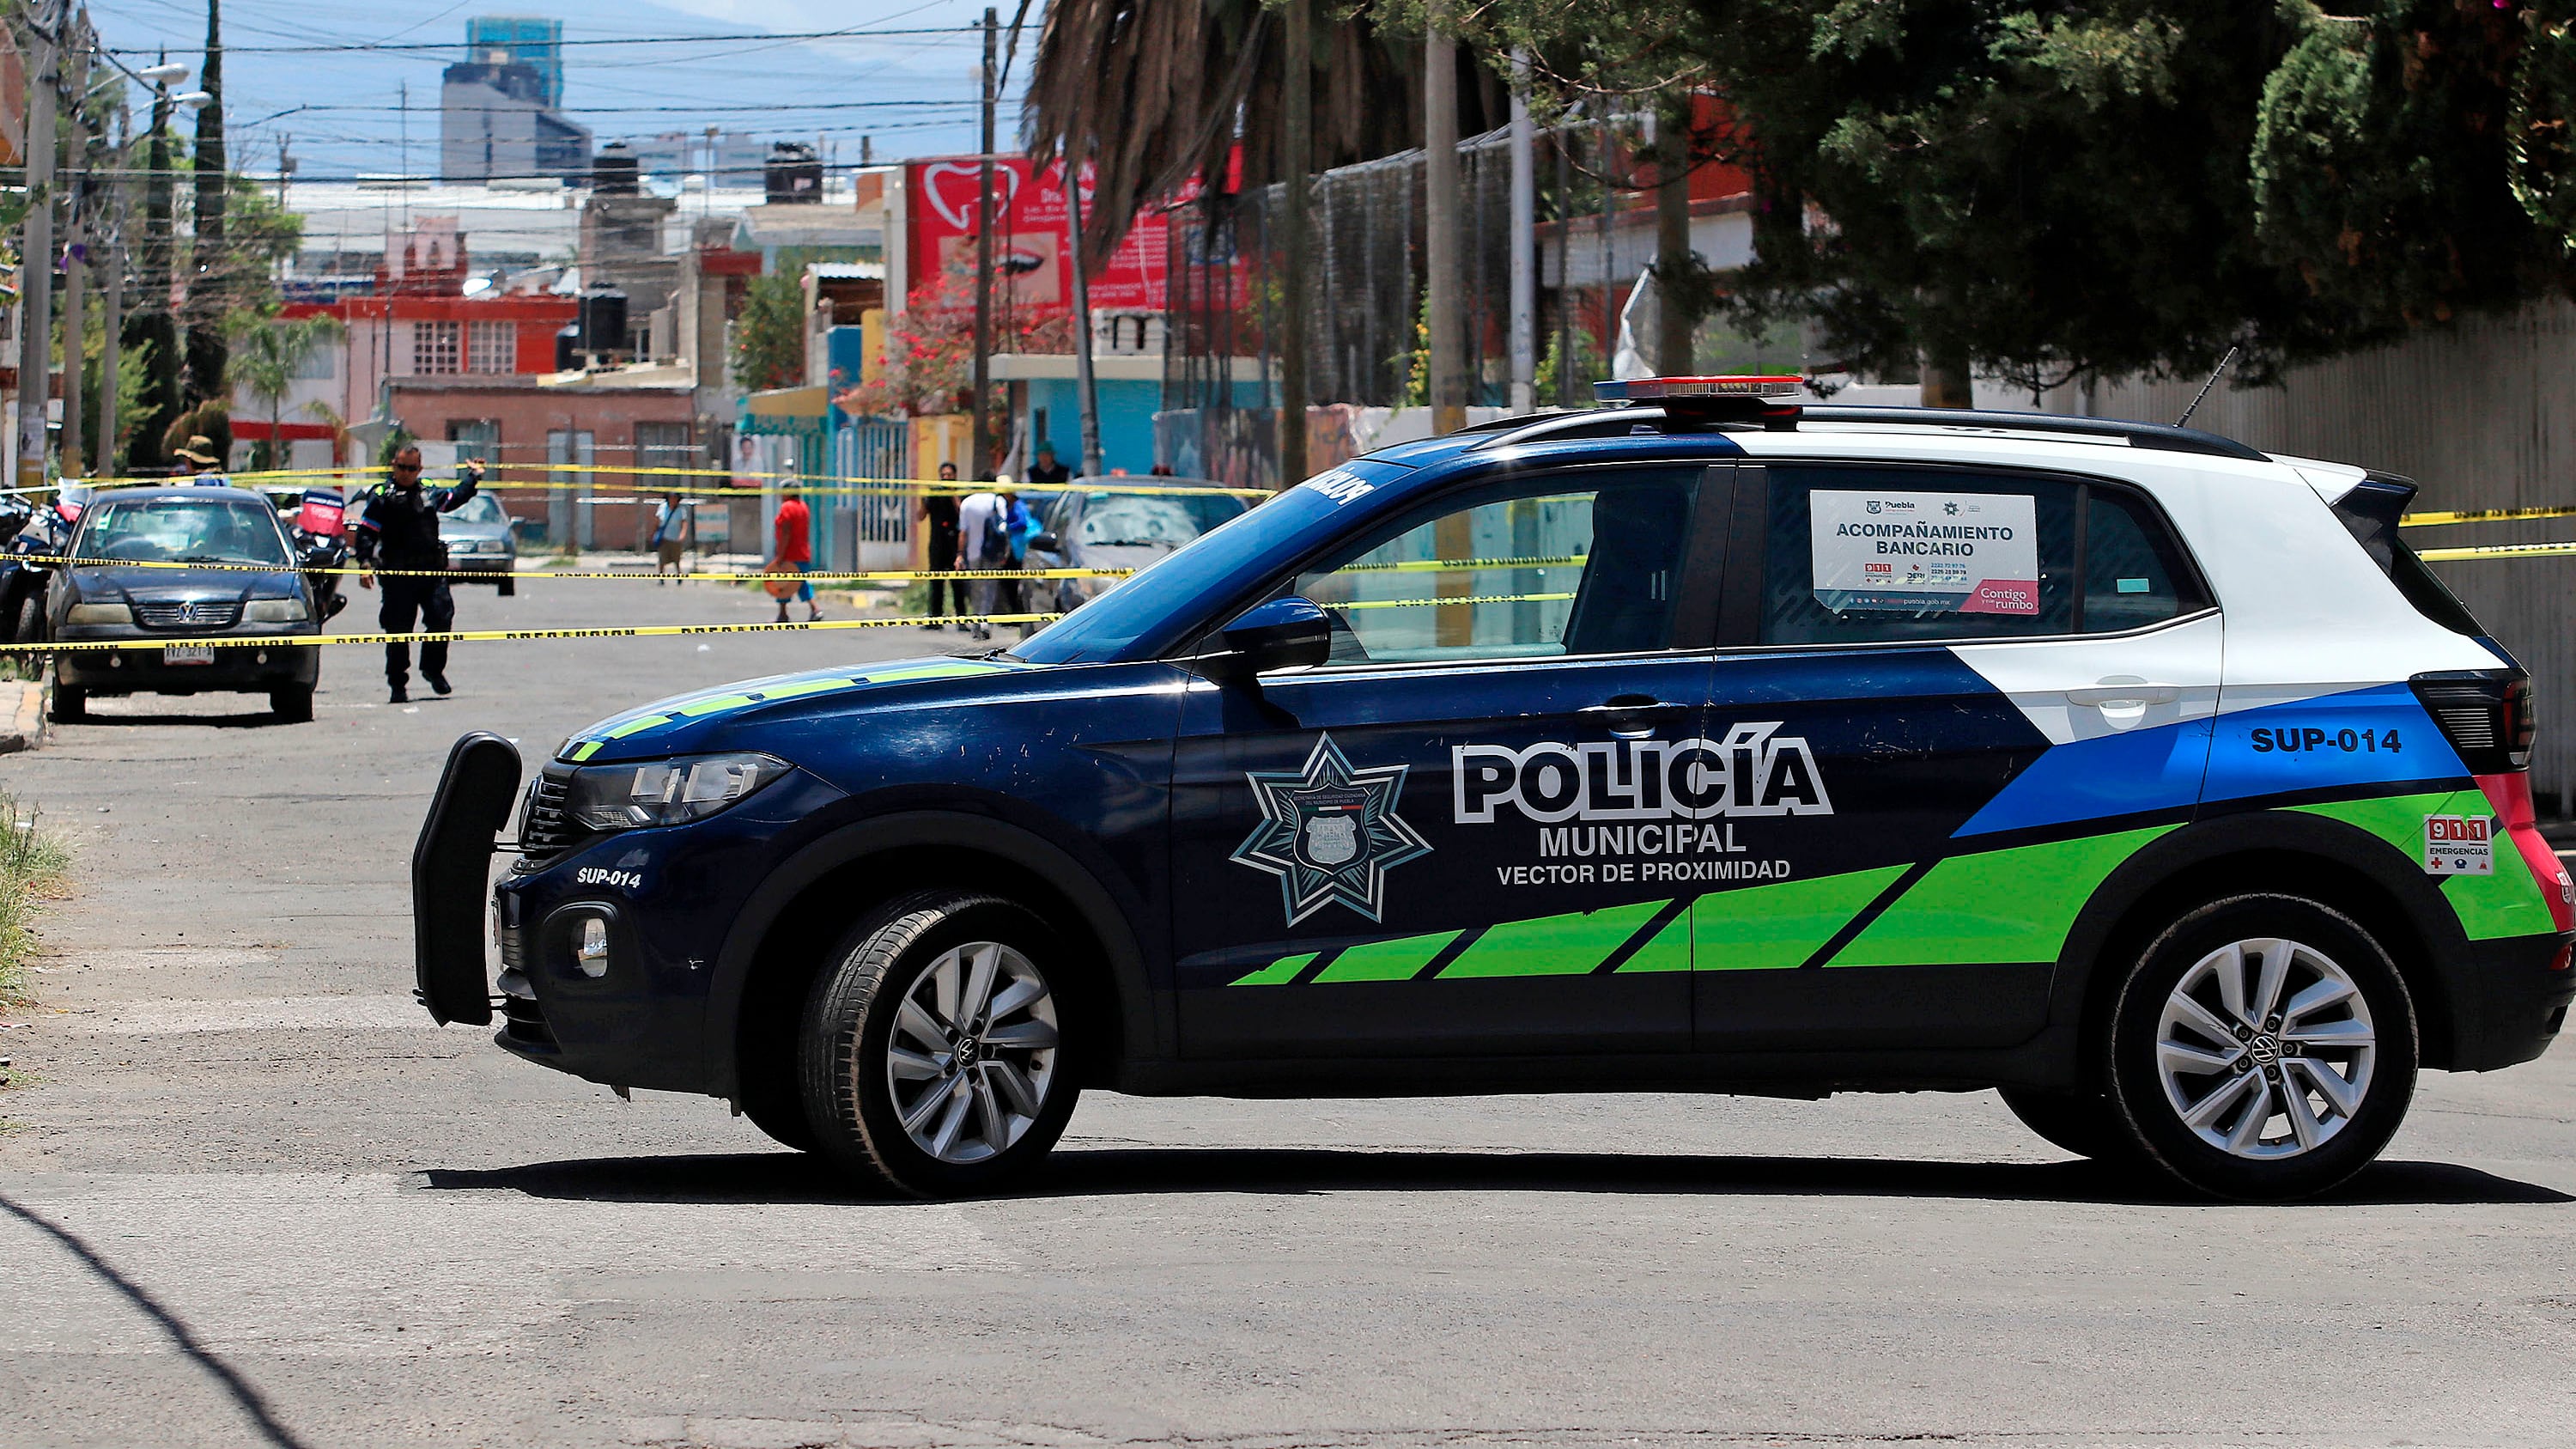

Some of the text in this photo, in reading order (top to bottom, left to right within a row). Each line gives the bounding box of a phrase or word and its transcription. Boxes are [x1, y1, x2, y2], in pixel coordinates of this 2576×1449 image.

[1836, 521, 2014, 540] ACOMPAÑAMIENTO
[1875, 540, 1975, 557] BANCARIO
[1866, 563, 1891, 572] 911
[1980, 588, 2027, 601] Contigo
[1996, 600, 2034, 610] rumbo
[2251, 728, 2403, 754] SUP-014
[1451, 721, 1835, 825] POLICÍA
[2431, 819, 2485, 839] 911
[1540, 823, 1747, 857] MUNICIPAL
[2429, 847, 2488, 855] EMERGENCIAS
[577, 867, 641, 889] SUP-014
[1497, 860, 1791, 886] VECTOR DE PROXIMIDAD
